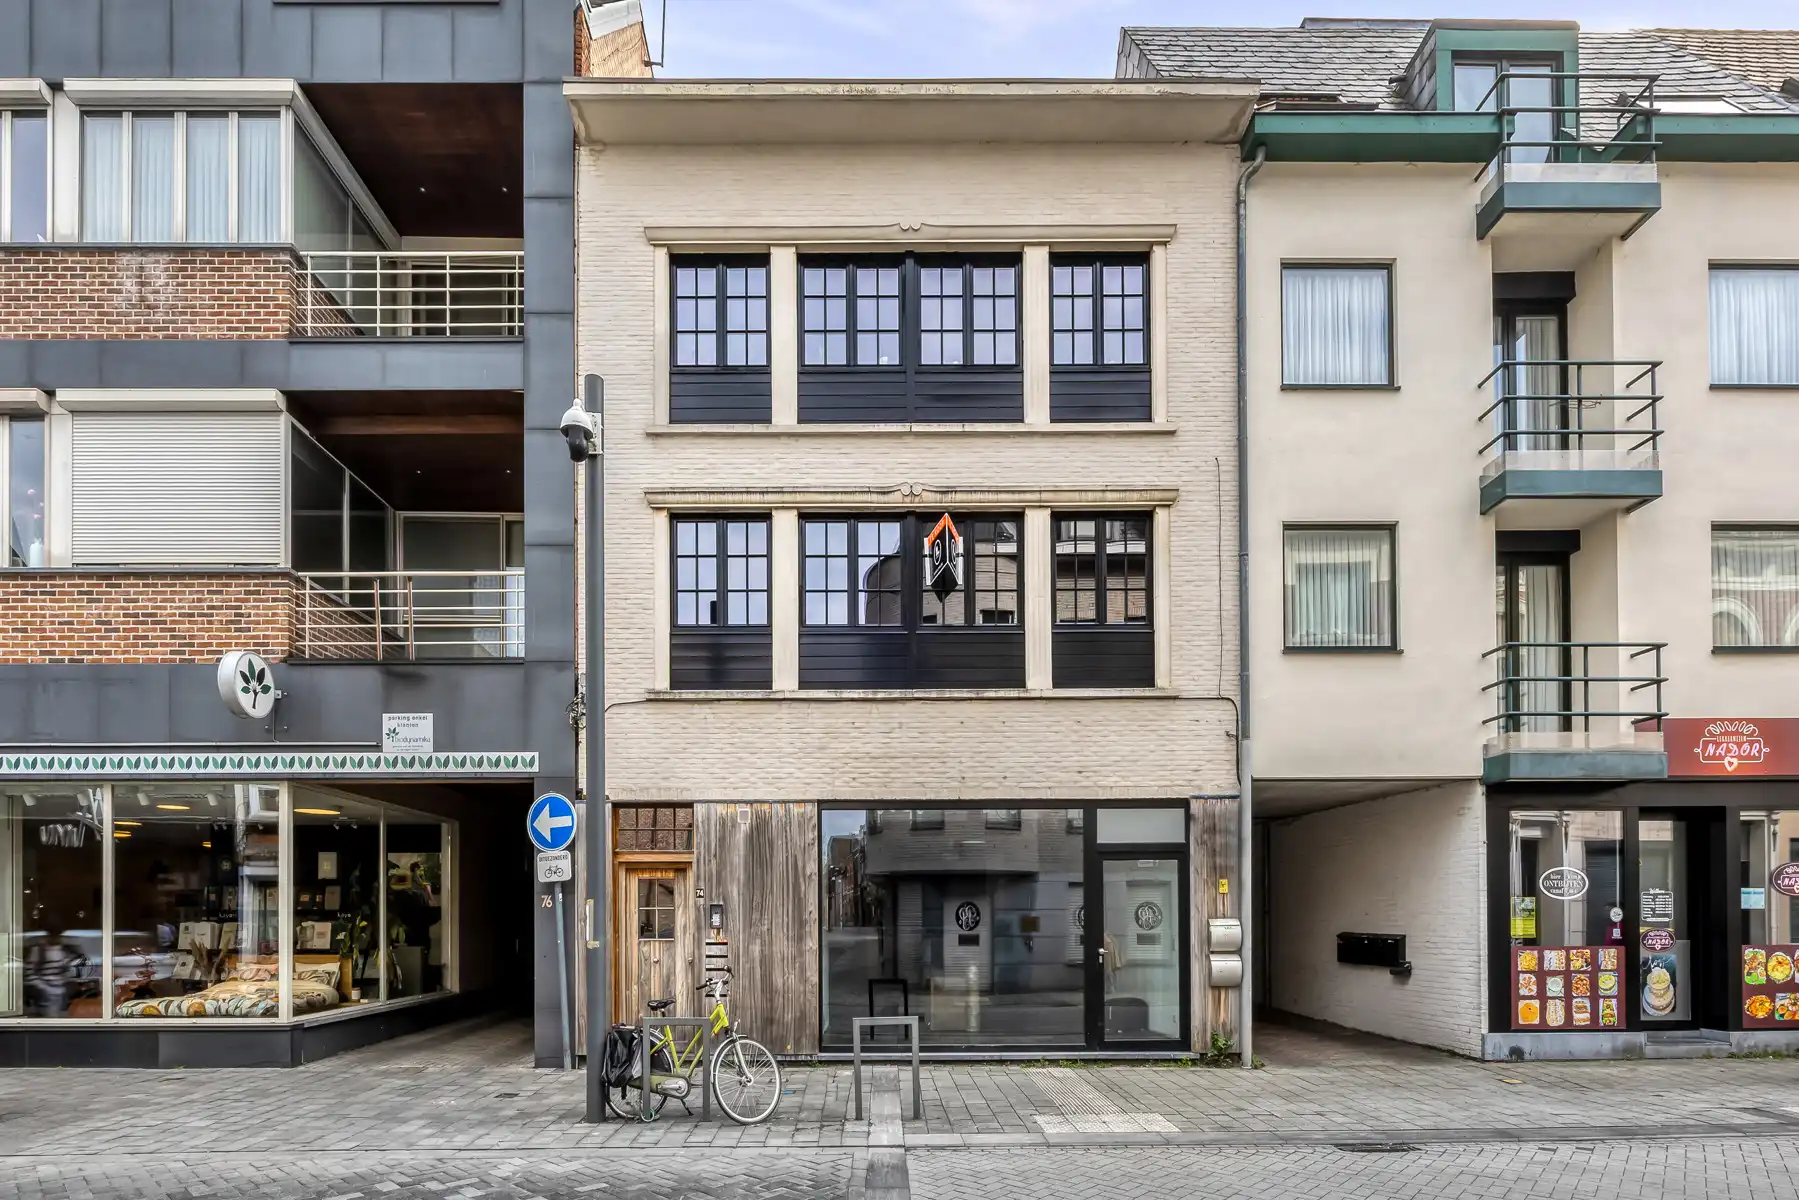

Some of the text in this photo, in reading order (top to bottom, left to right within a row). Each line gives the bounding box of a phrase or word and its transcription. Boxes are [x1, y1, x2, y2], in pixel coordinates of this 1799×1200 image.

[1704, 742, 1760, 757] NADOR
[1782, 877, 1799, 886] NAD
[696, 889, 704, 897] 74
[541, 895, 553, 908] 76
